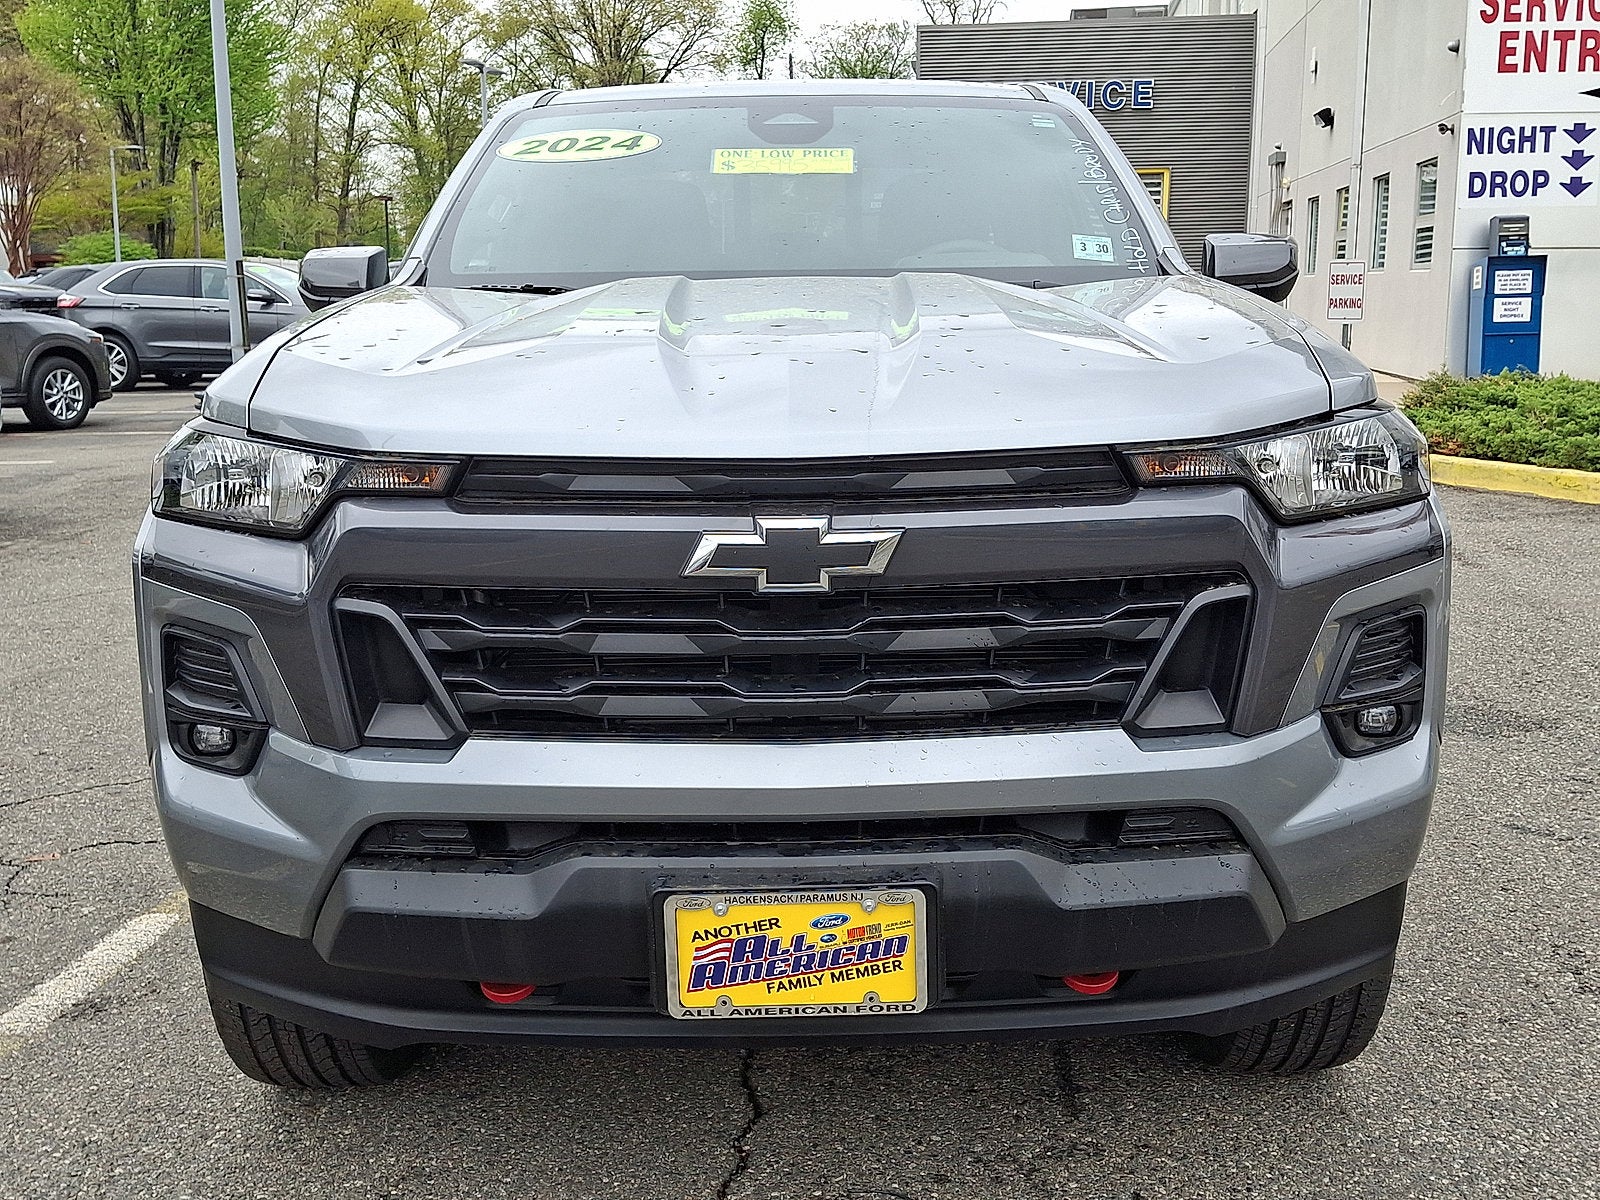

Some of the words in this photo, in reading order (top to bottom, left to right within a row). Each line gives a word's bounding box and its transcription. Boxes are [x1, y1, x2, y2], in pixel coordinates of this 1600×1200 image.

[1480, 0, 1600, 24] SERVI
[1498, 29, 1600, 73] ENTR
[512, 134, 645, 157] 2024
[1466, 125, 1557, 155] NIGHT
[720, 149, 752, 158] ONE
[760, 149, 795, 158] LOW
[802, 149, 849, 158] PRICE
[1468, 169, 1550, 199] DROP
[1079, 241, 1087, 252] 3
[1095, 243, 1109, 254] 30
[1330, 273, 1363, 286] SERVICE
[1329, 297, 1362, 309] PARKING
[724, 892, 848, 905] HACKENSACK/PARAMUS
[850, 892, 864, 901] NJ
[691, 917, 782, 943] ANOTHER
[847, 926, 866, 940] MOTOR
[865, 922, 882, 936] TREND
[730, 932, 817, 964] ALL
[687, 934, 910, 991] AMERICAN
[766, 973, 826, 995] FAMILY
[830, 959, 905, 984] MEMBER
[681, 1008, 724, 1018] ALL
[729, 1005, 848, 1016] AMERICAN
[855, 1003, 917, 1014] FORD
